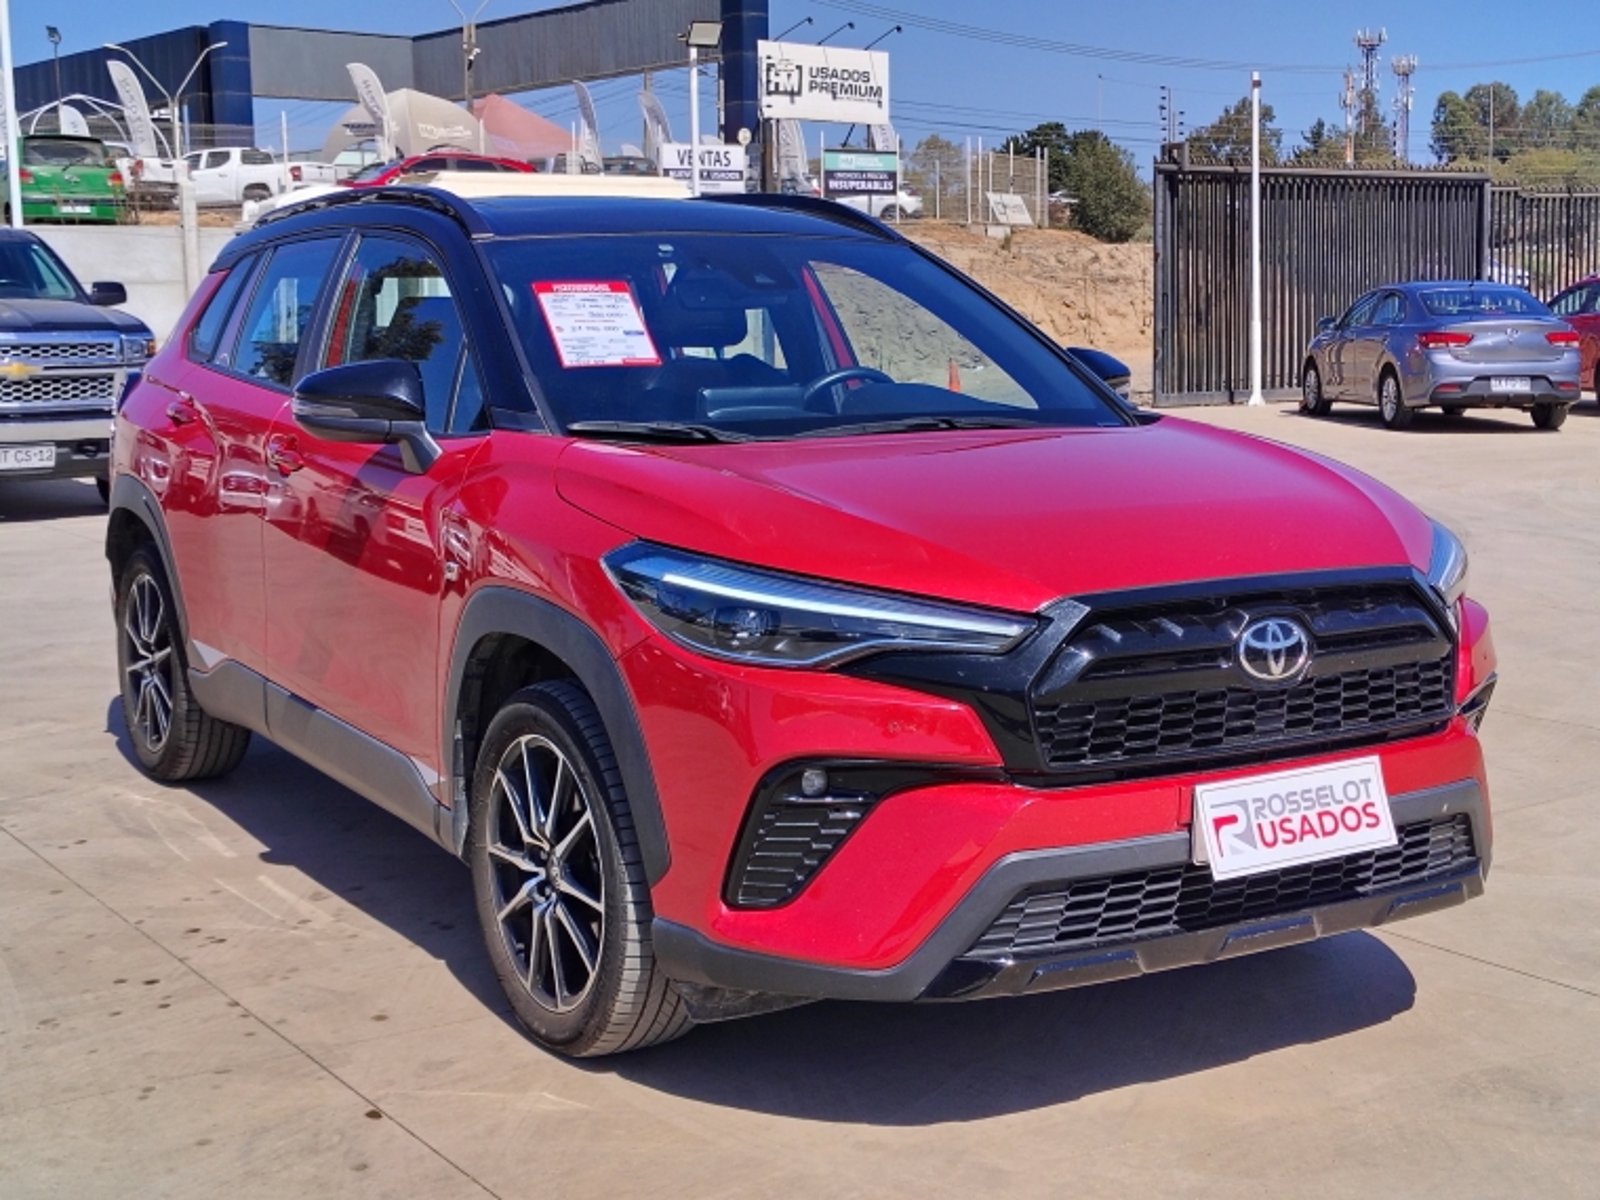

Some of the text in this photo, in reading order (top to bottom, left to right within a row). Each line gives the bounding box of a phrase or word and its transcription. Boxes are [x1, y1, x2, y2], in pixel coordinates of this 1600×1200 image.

[808, 66, 871, 83] USADOS
[808, 79, 883, 99] PREMIUM
[676, 148, 732, 168] VENTAS
[1252, 778, 1372, 820] ROSSELOT
[1256, 802, 1381, 848] USADOS
